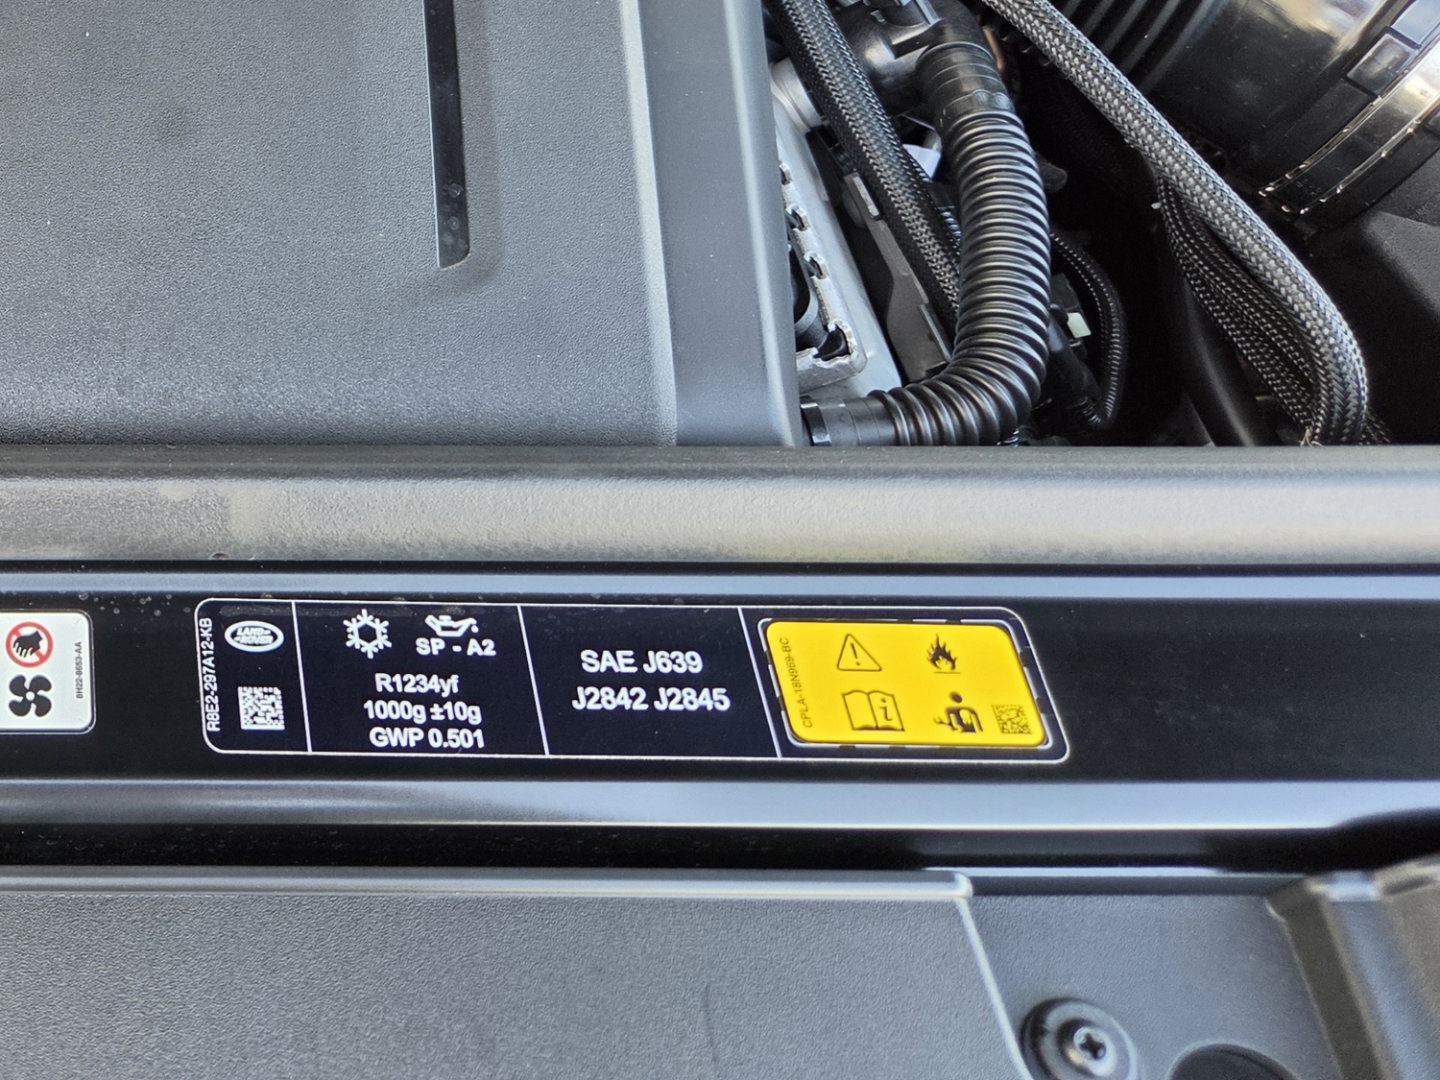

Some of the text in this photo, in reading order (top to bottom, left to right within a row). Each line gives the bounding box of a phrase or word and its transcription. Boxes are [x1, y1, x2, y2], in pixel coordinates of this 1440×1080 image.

[580, 649, 704, 673] SAE J639
[200, 618, 221, 732] R8E2-297A12-KB
[374, 672, 459, 698] R1234yf
[571, 686, 731, 711] J2842 J2845
[363, 700, 482, 725] 1000g ±10g
[369, 726, 485, 748] GWP 0.501
